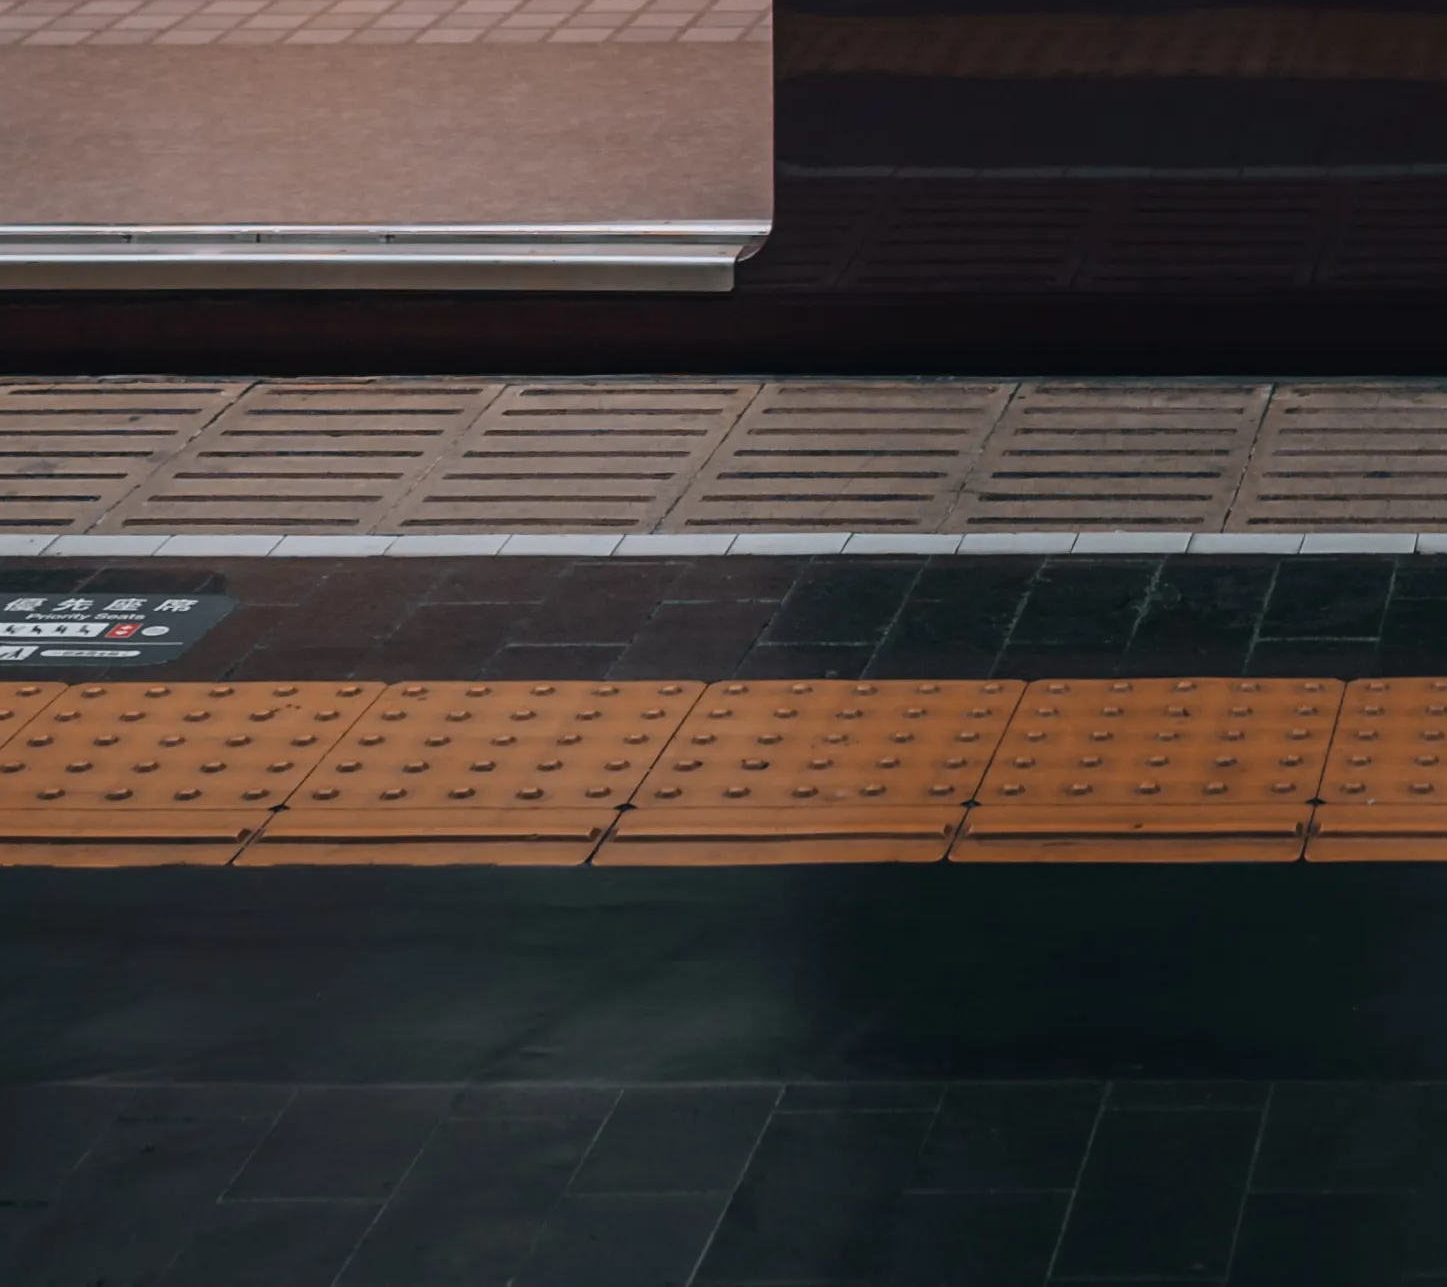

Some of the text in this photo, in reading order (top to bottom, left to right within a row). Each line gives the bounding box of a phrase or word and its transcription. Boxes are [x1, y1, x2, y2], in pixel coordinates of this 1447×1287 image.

[3, 597, 199, 613] 優先座席
[26, 613, 92, 621] Priority
